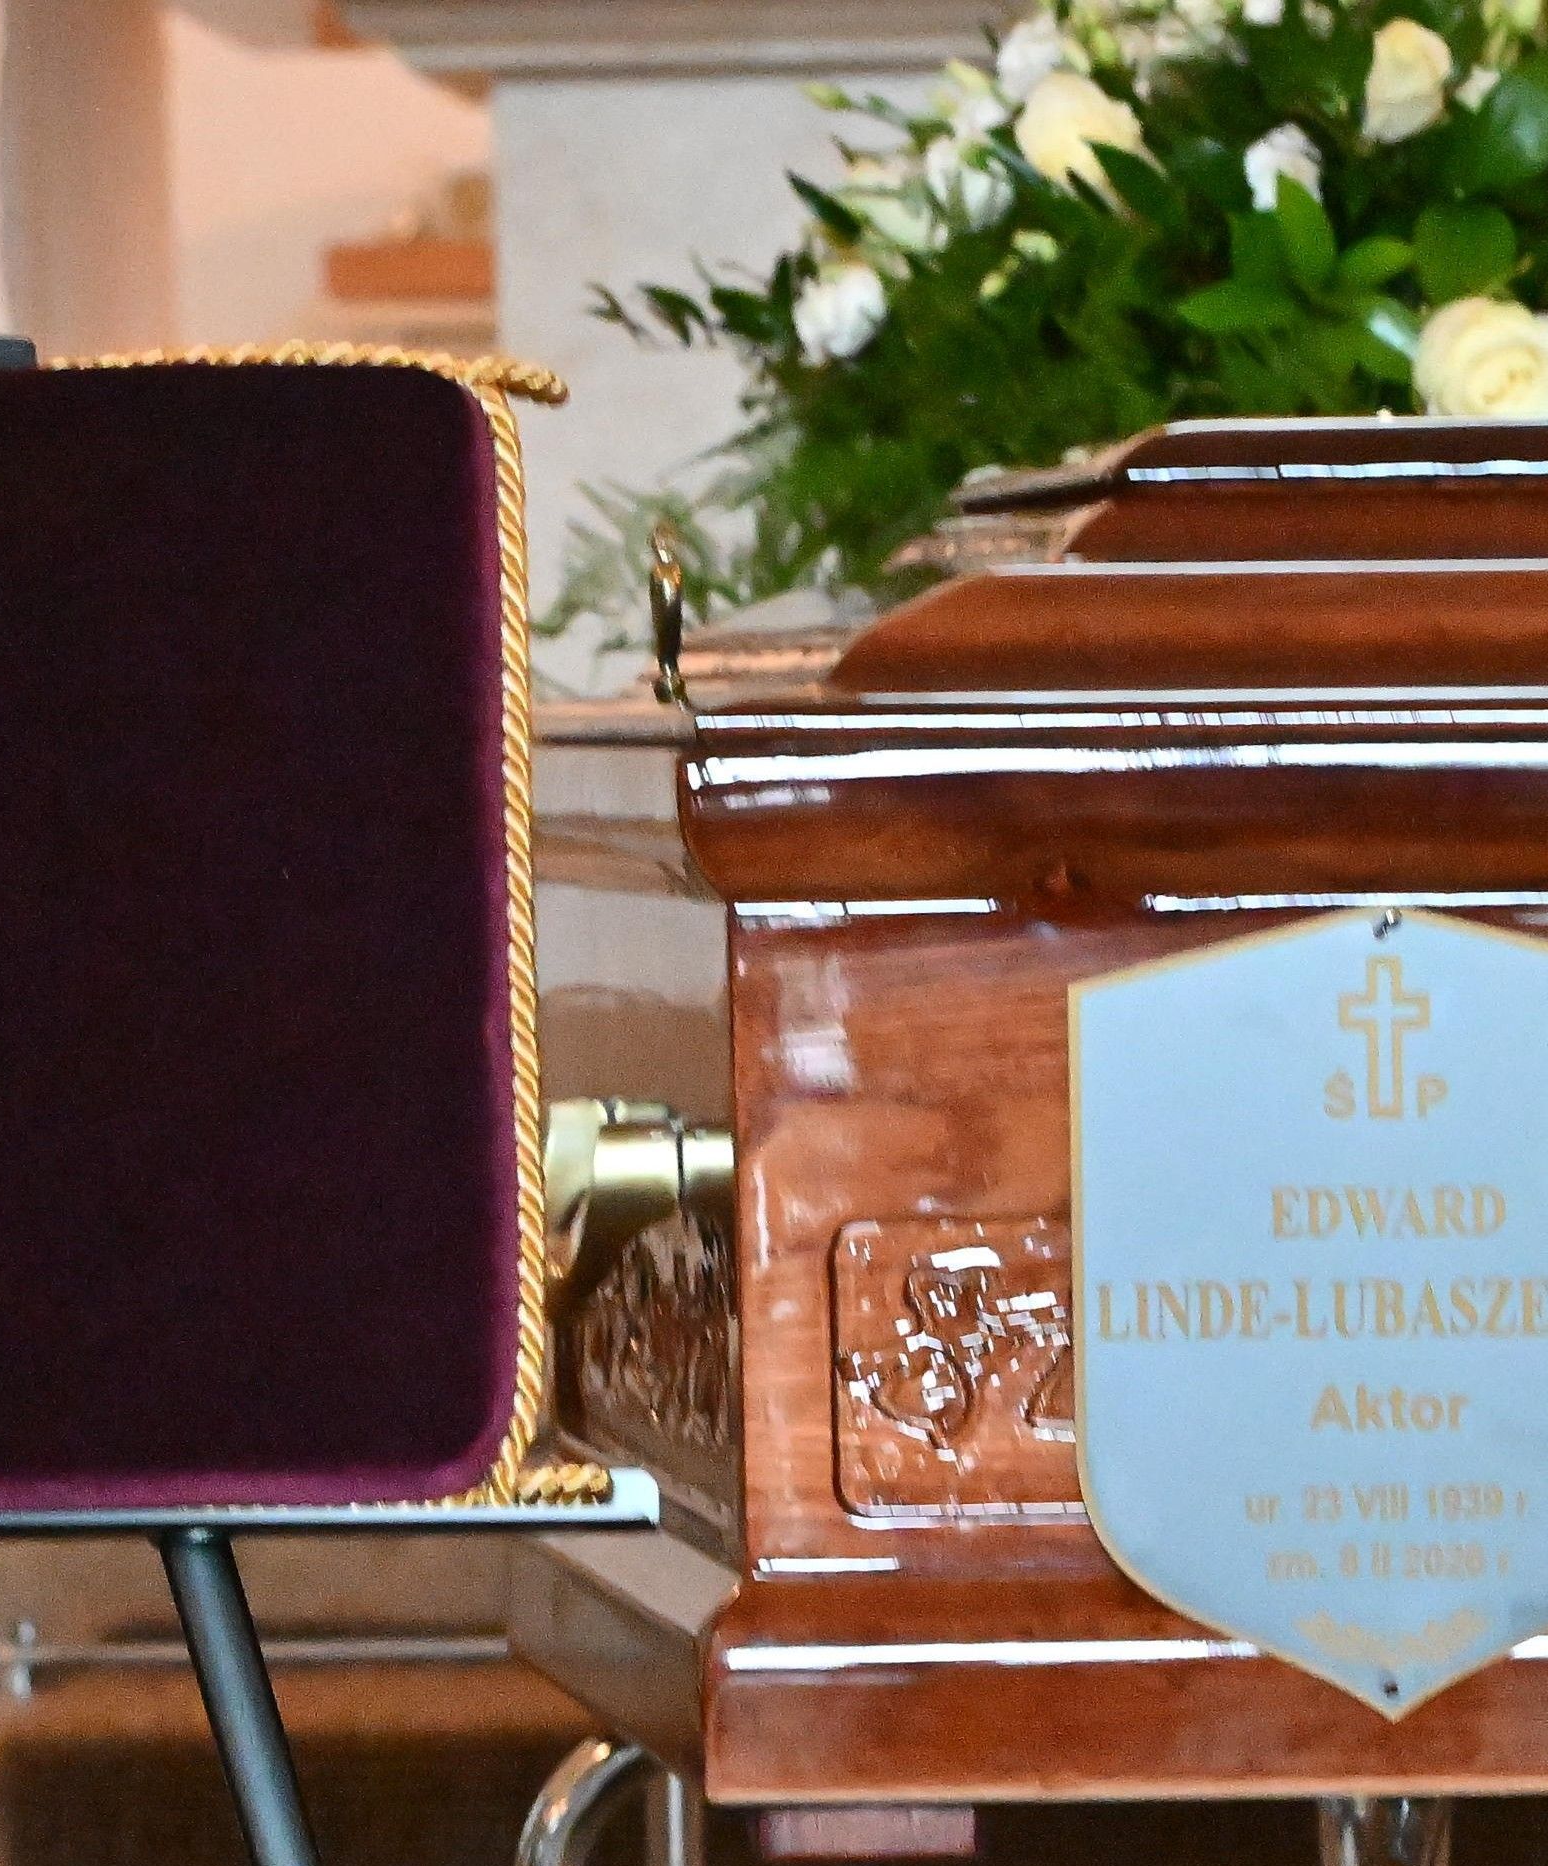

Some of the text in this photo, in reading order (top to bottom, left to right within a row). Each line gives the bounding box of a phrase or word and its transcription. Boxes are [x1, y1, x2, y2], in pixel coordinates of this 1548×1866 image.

[1411, 1071, 1450, 1121] P
[1269, 1181, 1510, 1242] EDWARD
[1308, 1380, 1473, 1436] Aktor
